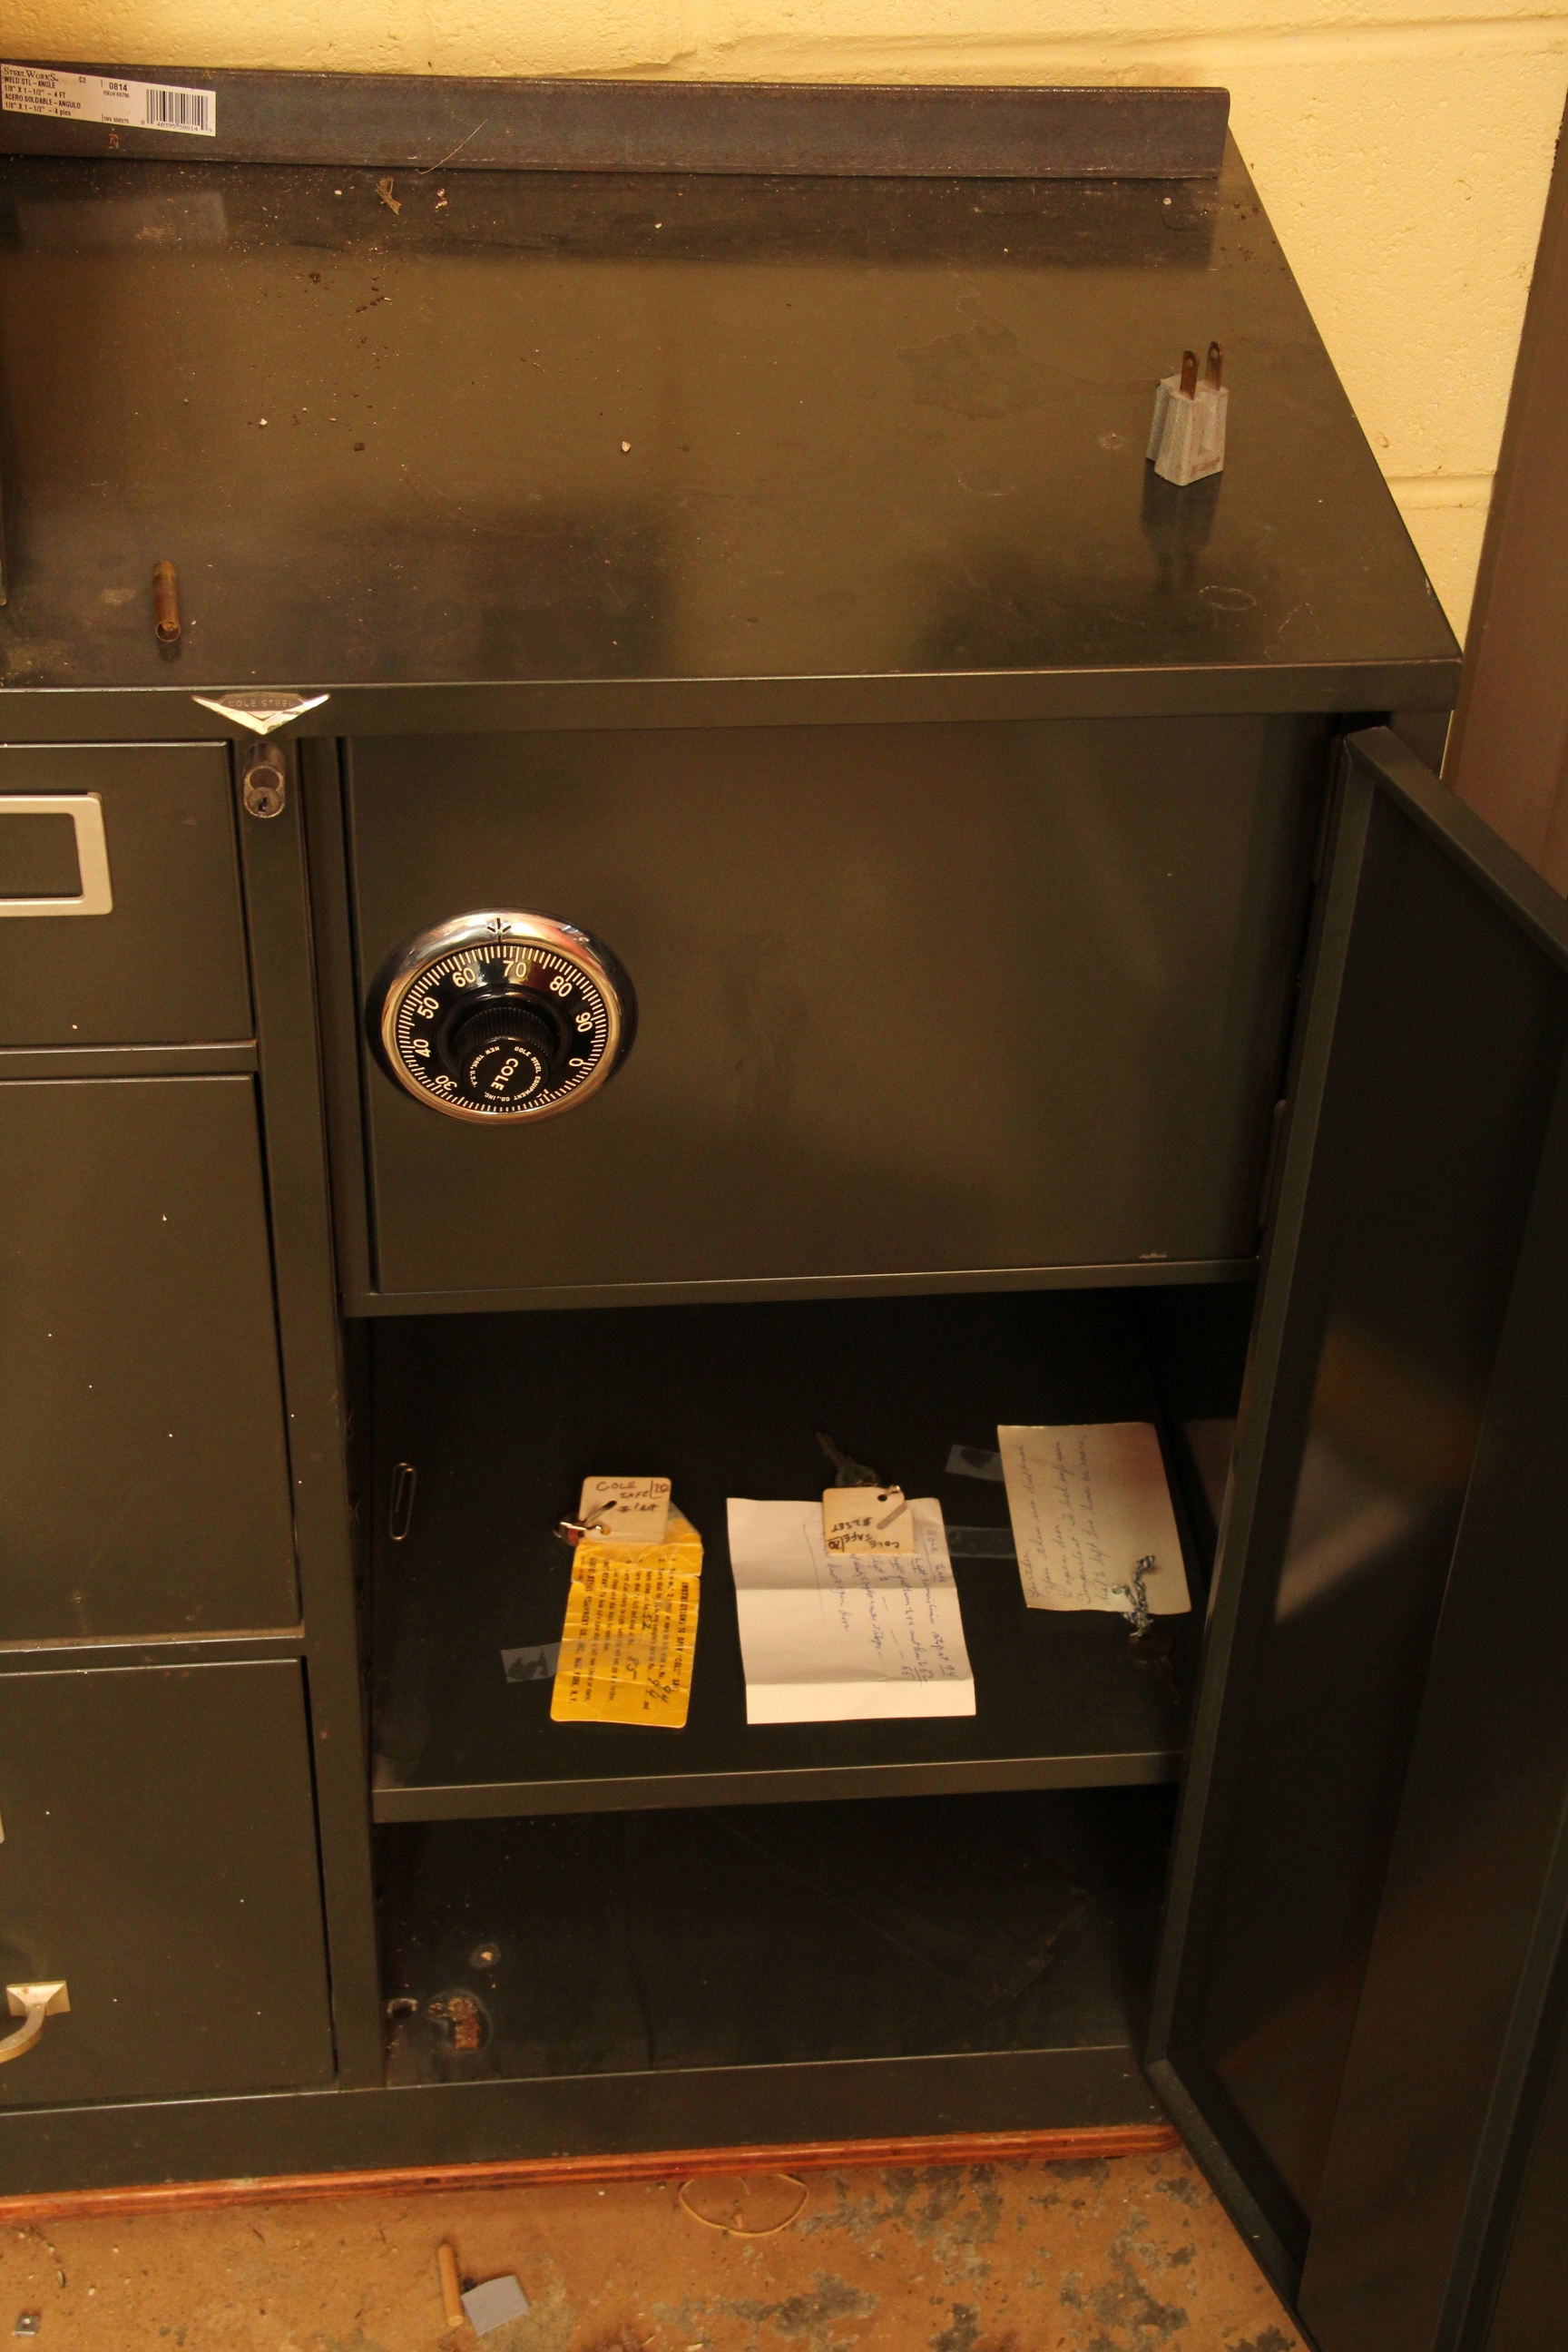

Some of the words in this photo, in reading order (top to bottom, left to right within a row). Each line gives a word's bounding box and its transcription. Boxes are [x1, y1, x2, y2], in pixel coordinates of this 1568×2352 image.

[4, 76, 20, 84] WELD
[21, 78, 32, 86] STL
[37, 81, 56, 89] ANGLE
[5, 93, 24, 102] ACERO
[24, 95, 53, 105] SOLDABLE
[59, 100, 81, 109] ANGULO
[228, 700, 257, 708] COLE
[260, 700, 295, 708] STEEL
[503, 959, 527, 978] 70
[452, 967, 476, 988] 60
[549, 975, 573, 997] 80
[417, 996, 440, 1019] 50
[575, 1012, 593, 1033] 90
[413, 1038, 431, 1058] 40
[485, 1045, 500, 1055] NEW
[514, 1046, 532, 1056] COLE
[531, 1056, 542, 1073] STEEL
[568, 1057, 584, 1067] 0
[435, 1074, 457, 1092] 30
[491, 1058, 519, 1091] COLE
[514, 1075, 542, 1101] EQUIPMENT
[596, 1481, 636, 1492] COLE
[843, 1532, 872, 1544] SAFE
[679, 1582, 688, 1623] INSTRCTIONS
[642, 1613, 652, 1630] 52
